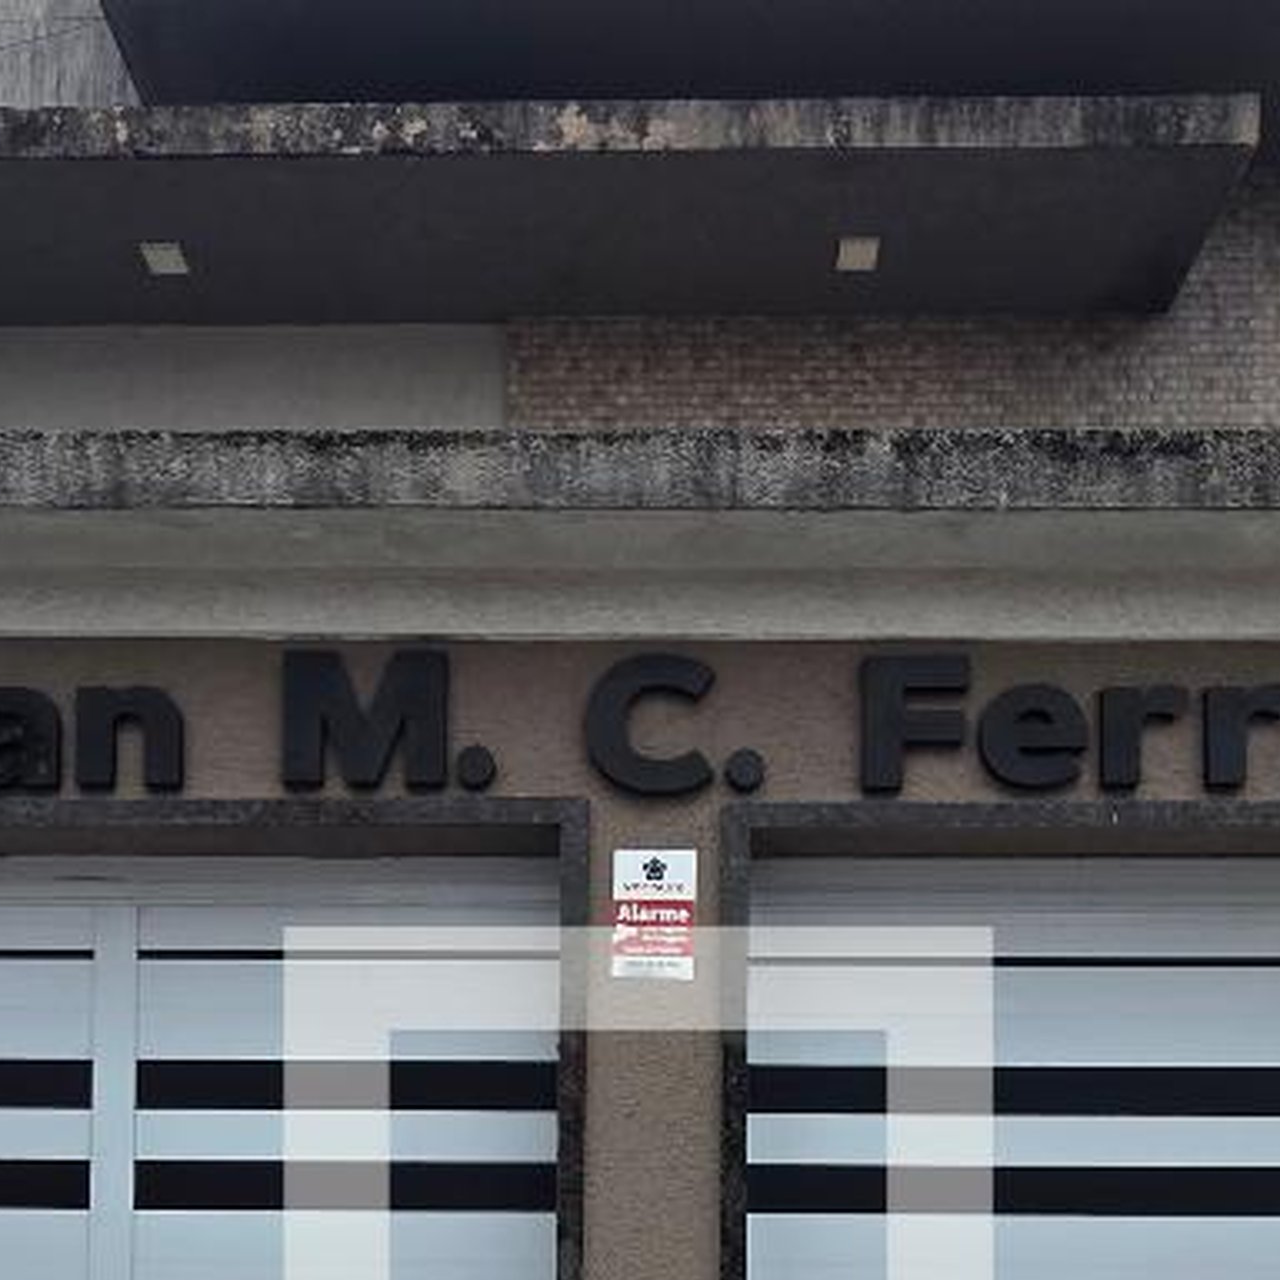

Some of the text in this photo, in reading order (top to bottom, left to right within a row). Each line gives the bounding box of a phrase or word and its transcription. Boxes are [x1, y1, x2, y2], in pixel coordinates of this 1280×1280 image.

[281, 649, 497, 791] M.
[584, 652, 765, 796] C.
[616, 902, 691, 923] Alarme
